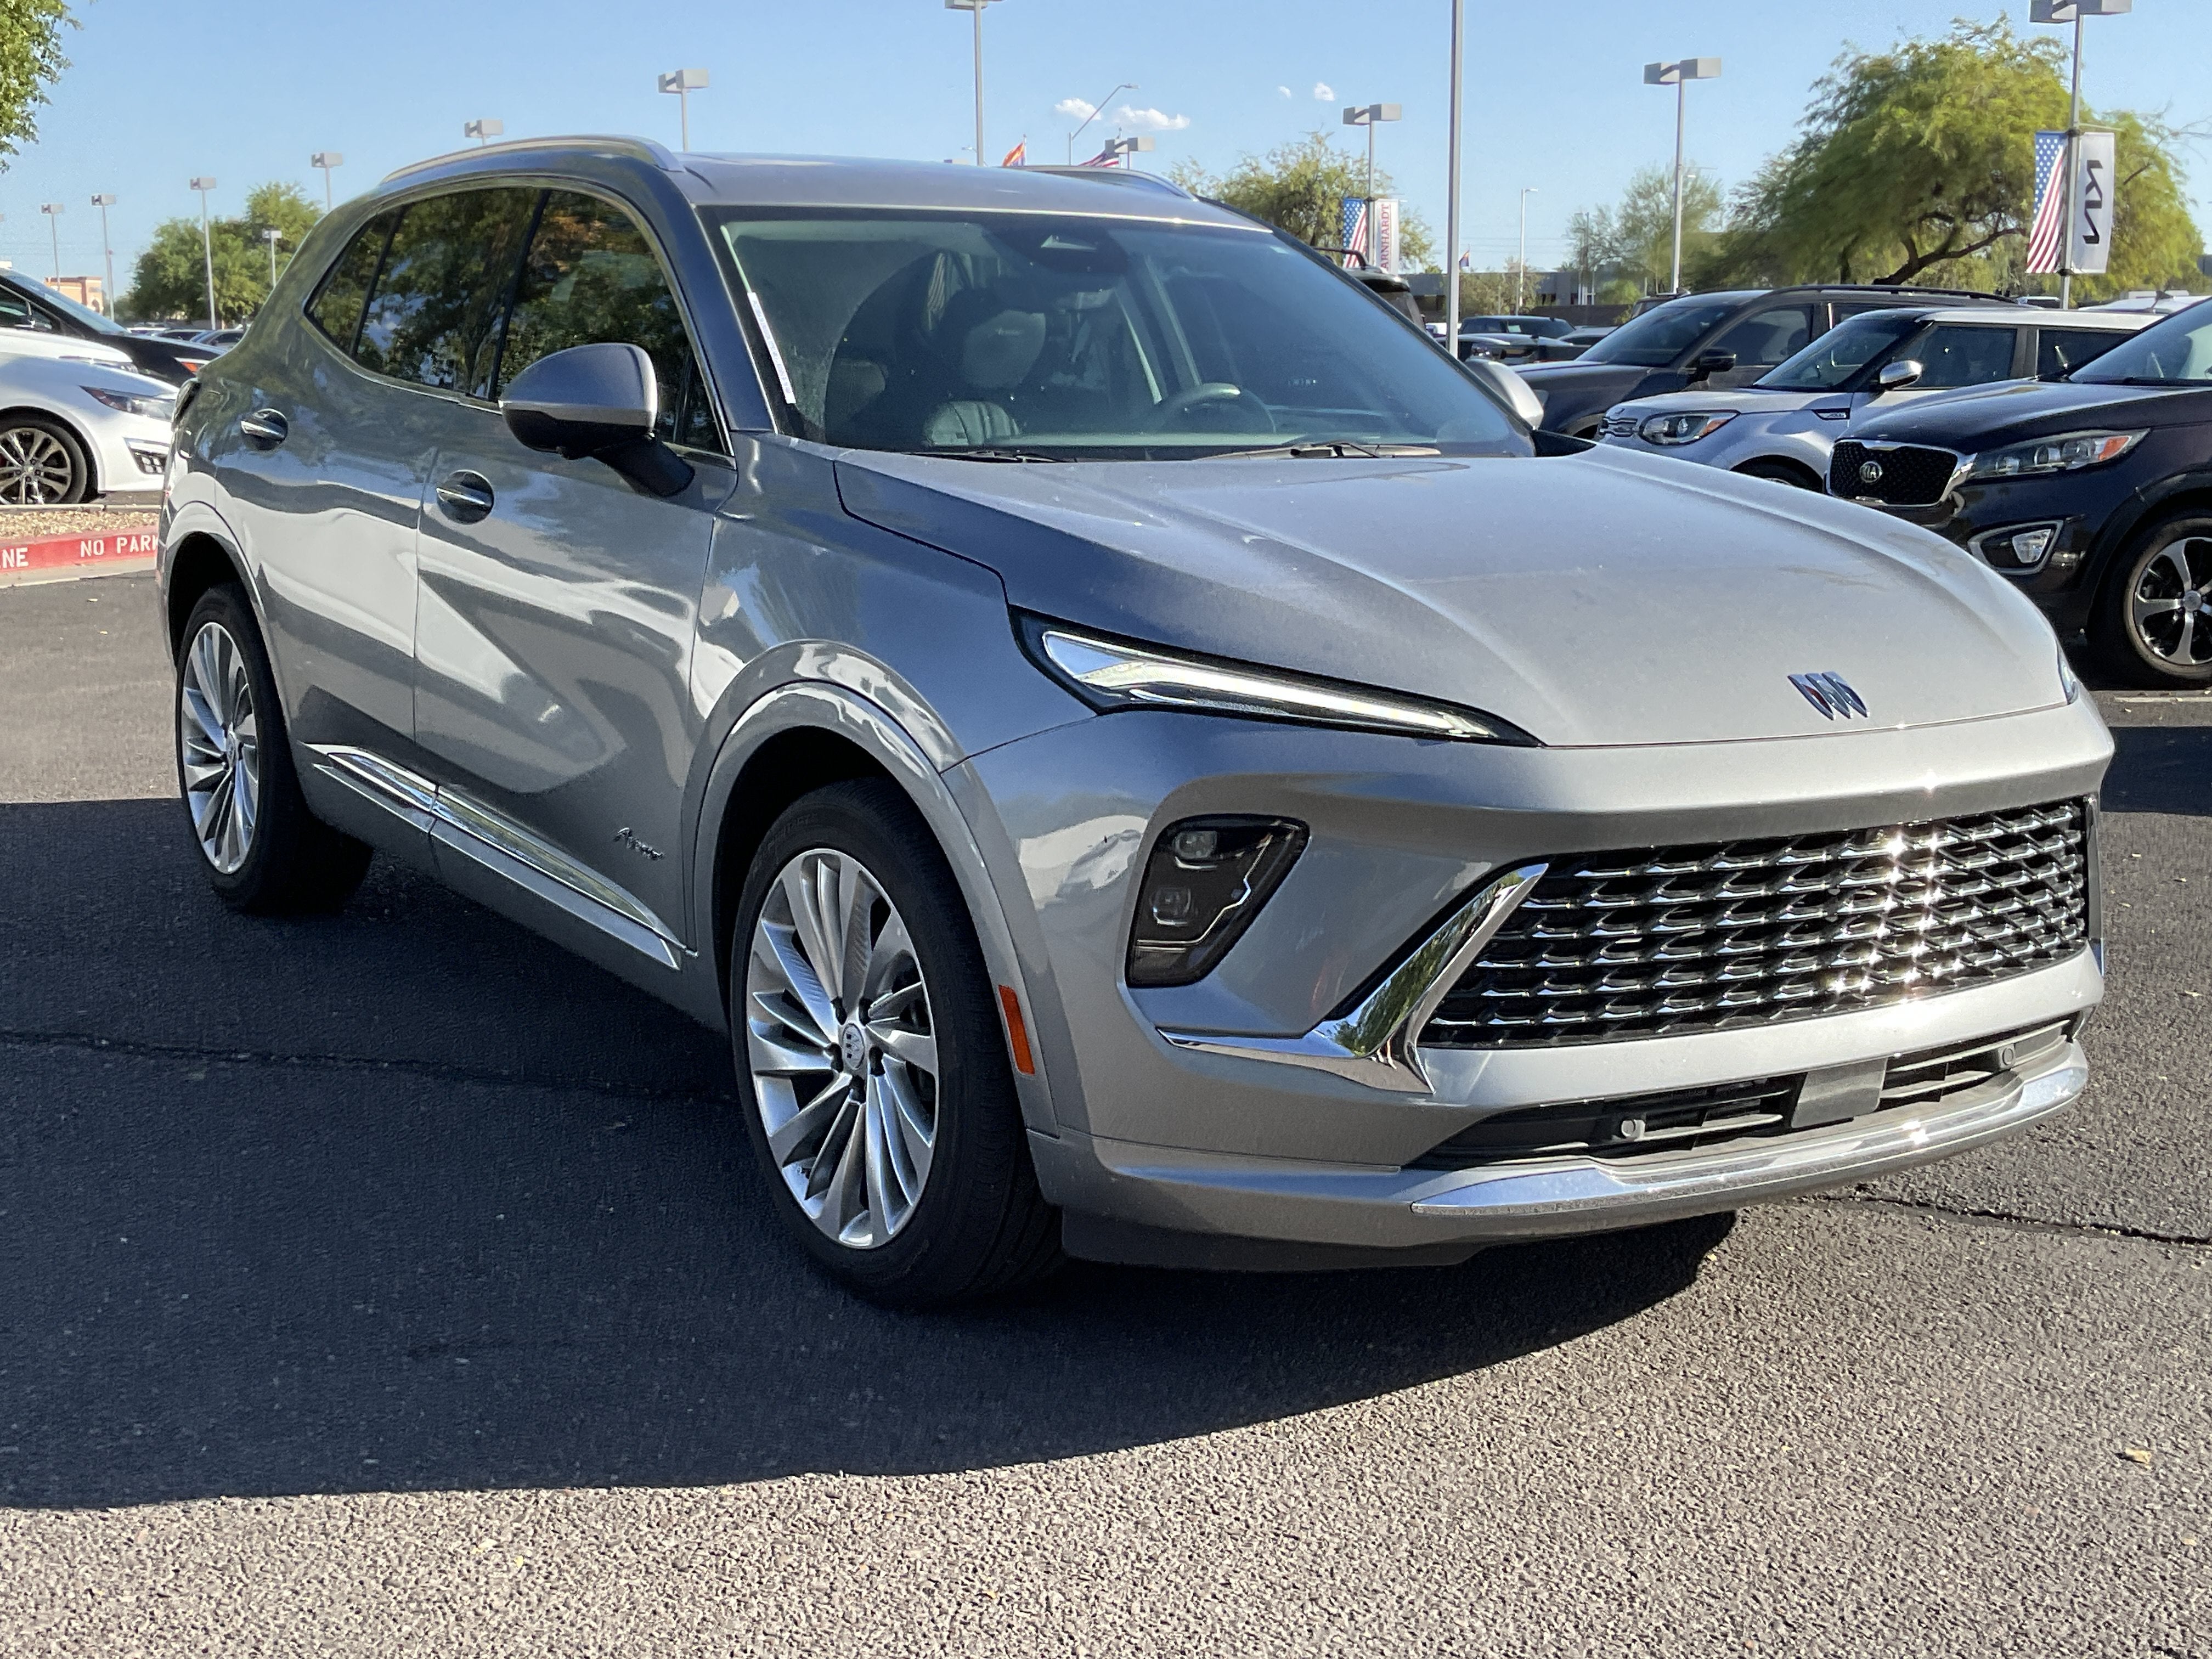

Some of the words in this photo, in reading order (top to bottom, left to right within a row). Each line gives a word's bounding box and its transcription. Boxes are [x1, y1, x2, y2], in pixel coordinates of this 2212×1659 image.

[2083, 160, 2103, 245] KIA
[0, 548, 29, 568] NE
[81, 539, 104, 557] NO
